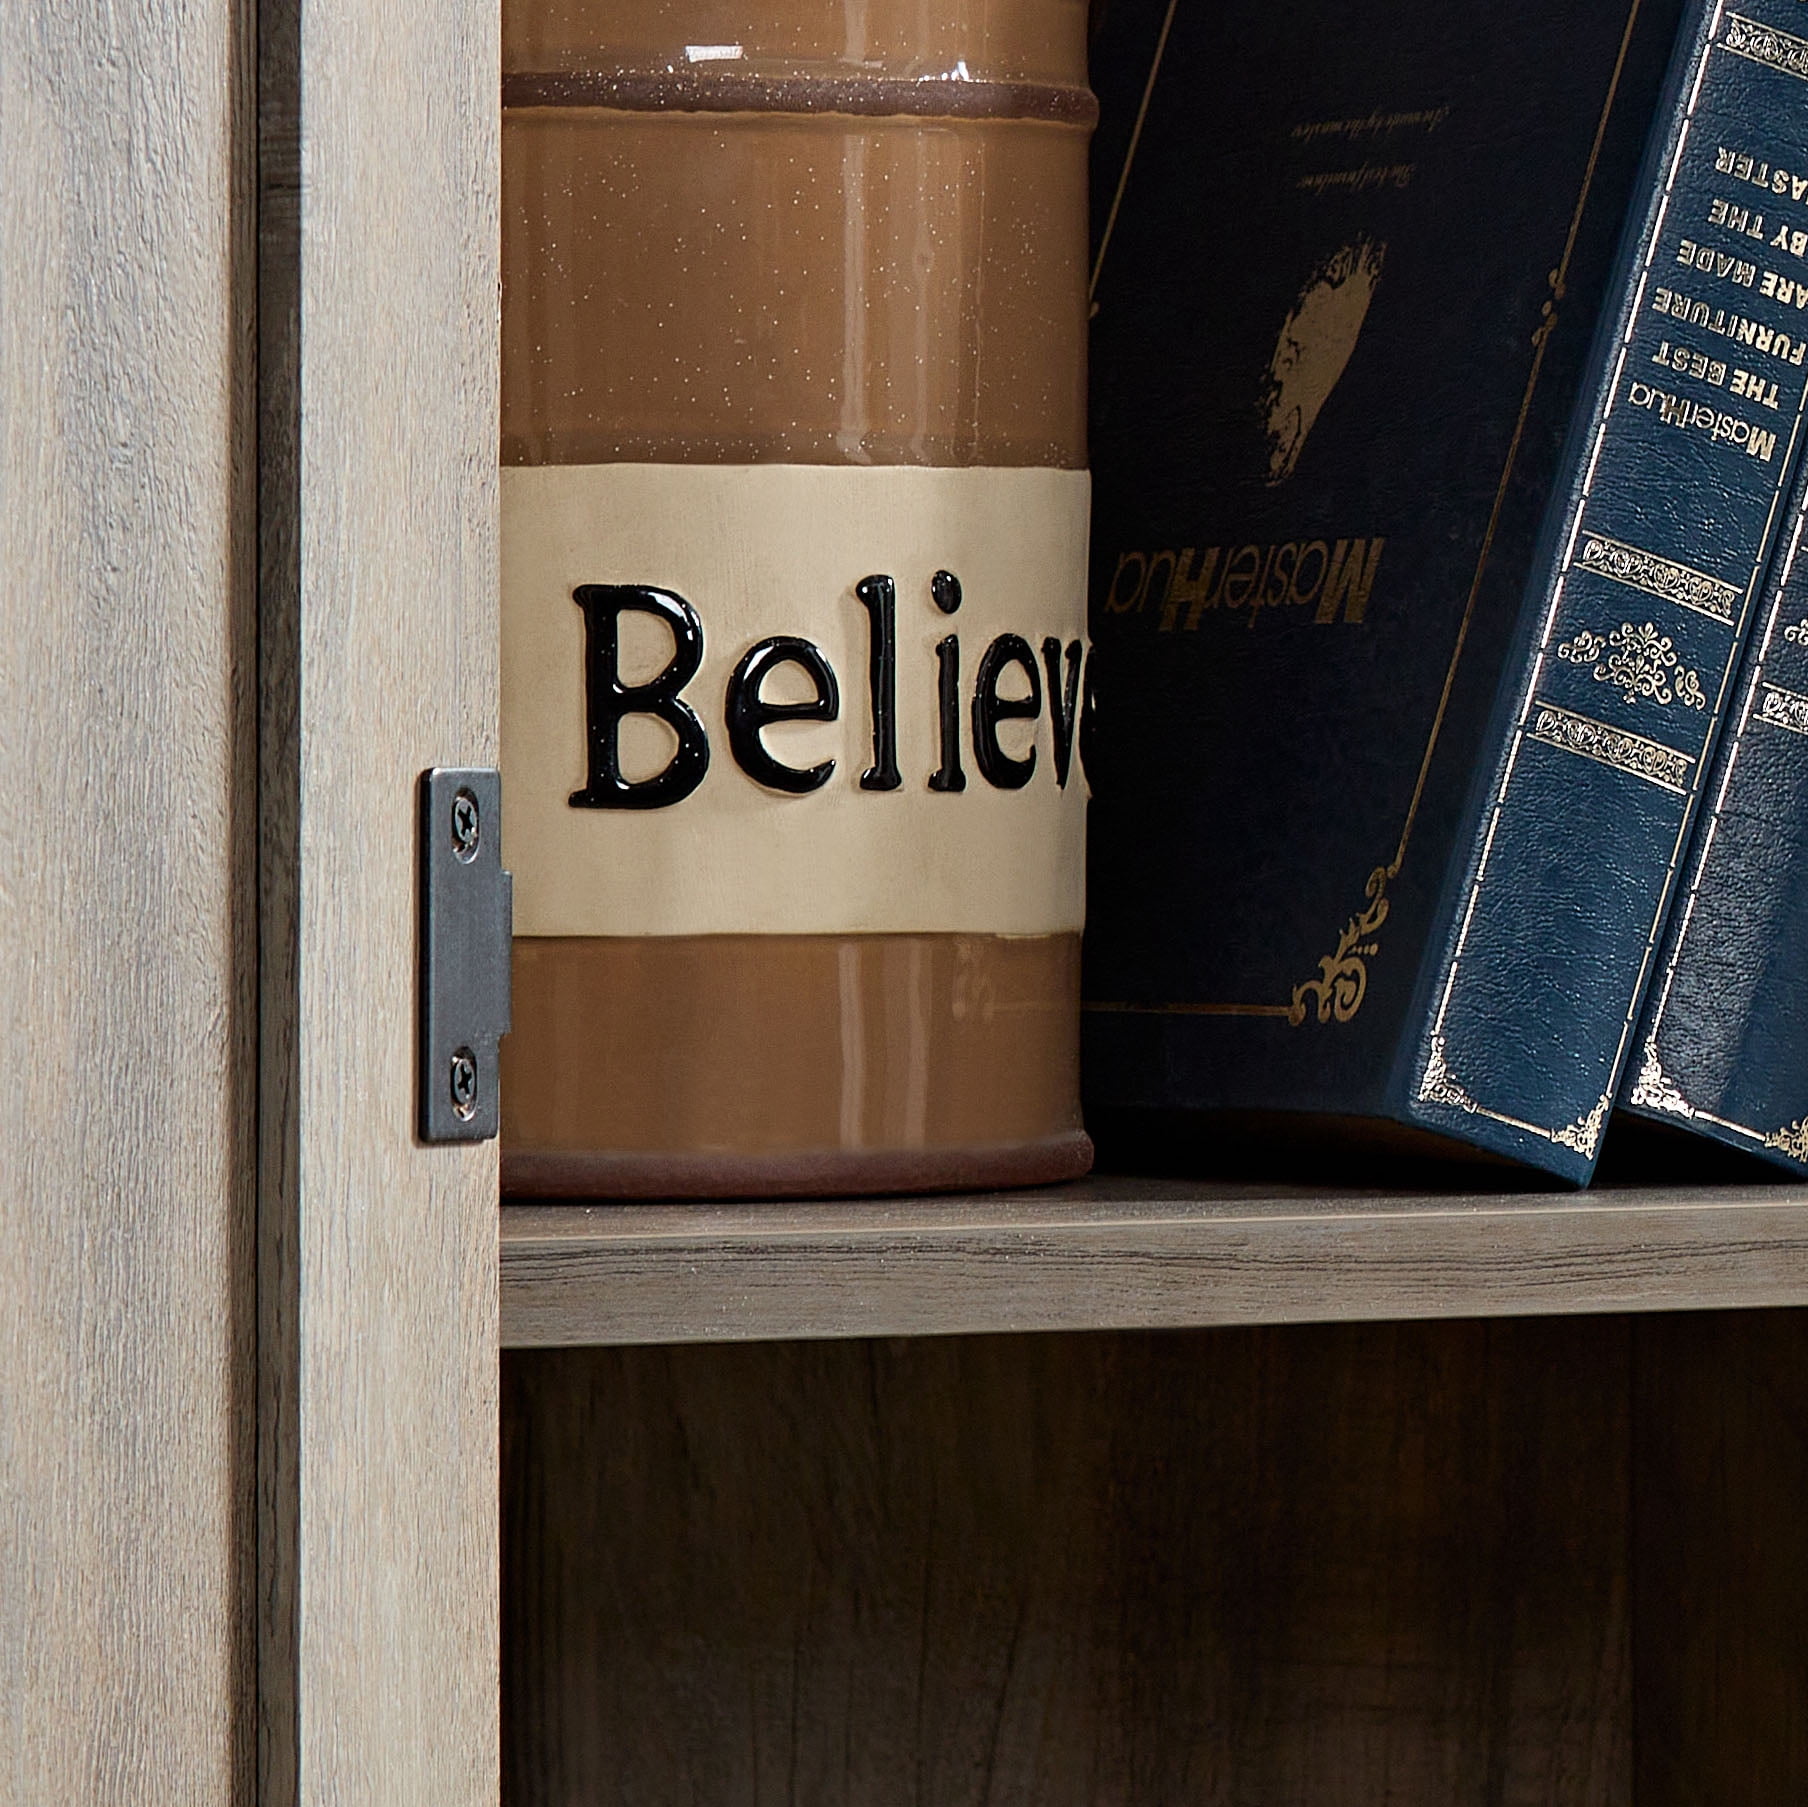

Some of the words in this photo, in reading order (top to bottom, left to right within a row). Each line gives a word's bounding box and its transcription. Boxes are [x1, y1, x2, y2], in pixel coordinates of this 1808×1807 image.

[1708, 199, 1764, 239] THE
[1769, 225, 1808, 258] BY
[1676, 238, 1757, 288] MADE
[1652, 287, 1808, 367] FURNITURE
[1651, 340, 1727, 386] BEST
[1729, 369, 1780, 411] THE
[1628, 381, 1776, 462] MasterHua
[1102, 536, 1386, 632] MasterHua
